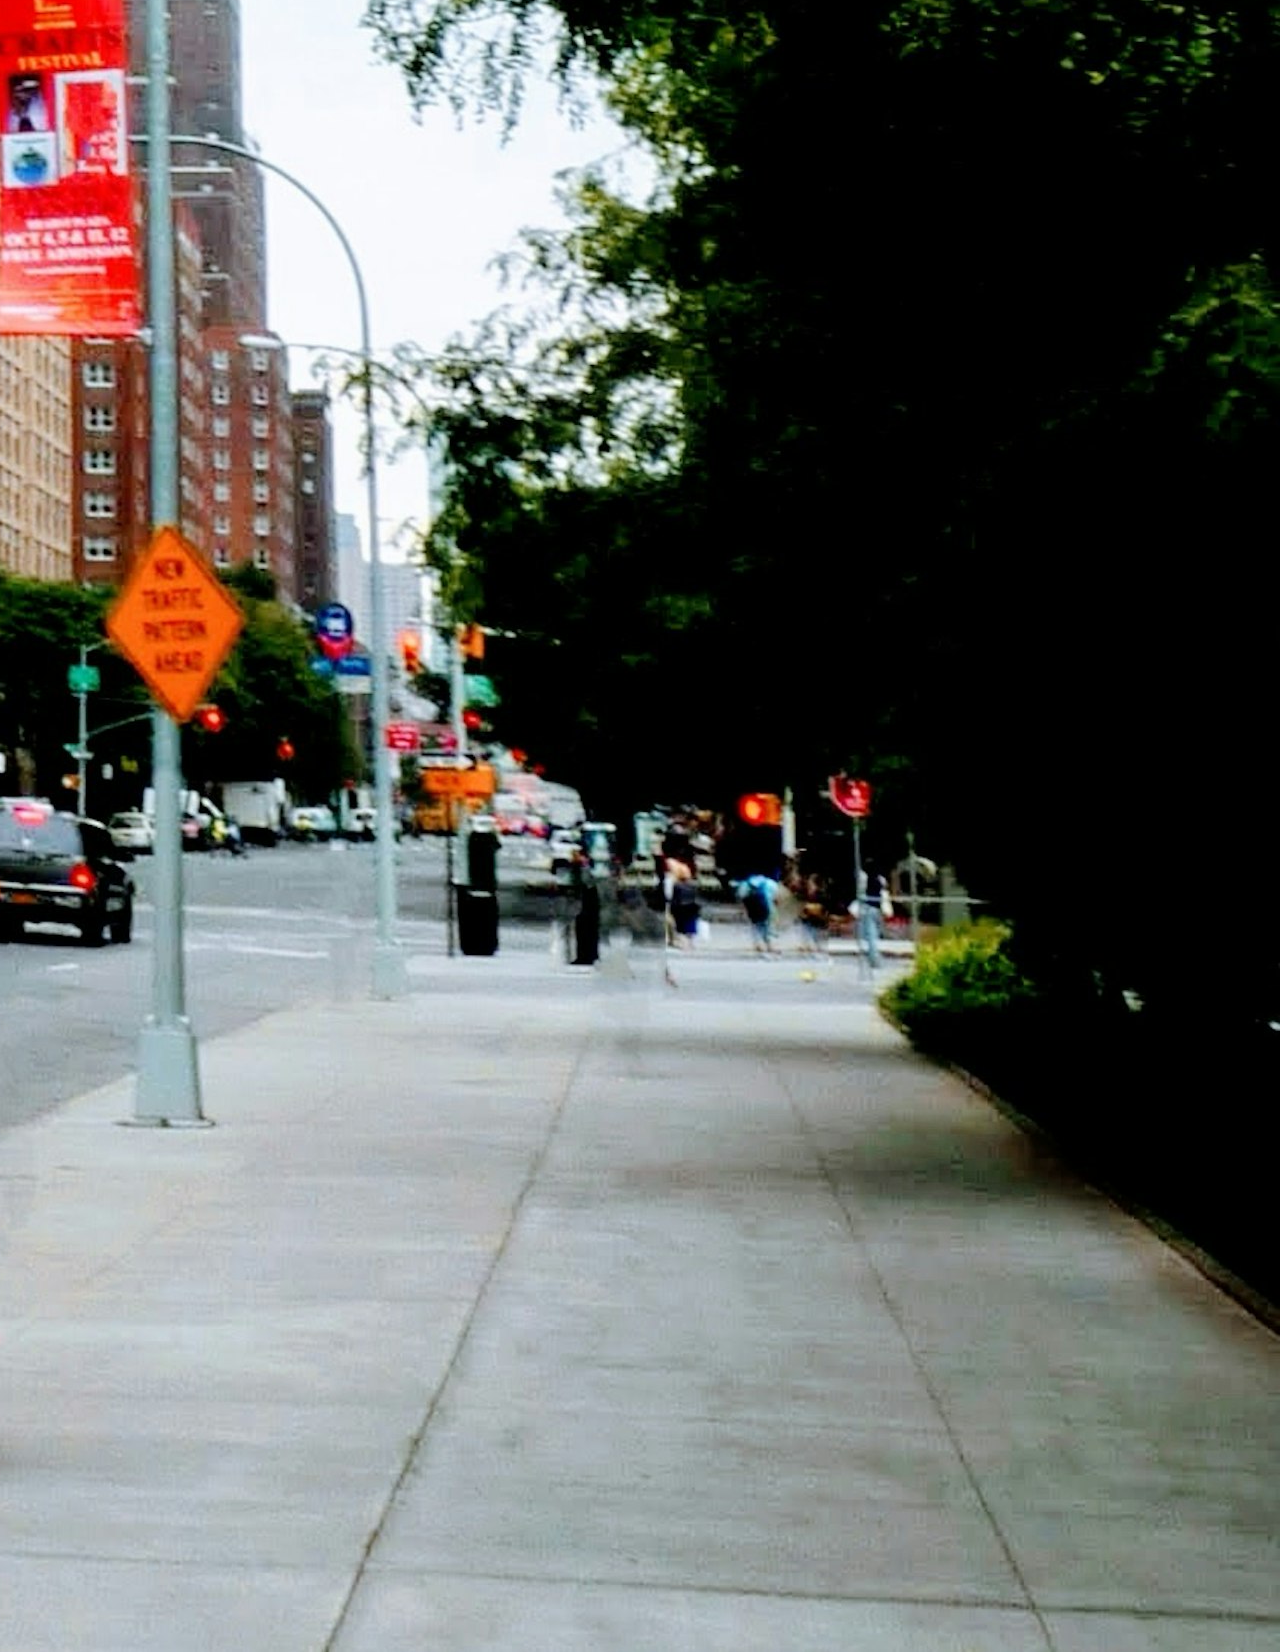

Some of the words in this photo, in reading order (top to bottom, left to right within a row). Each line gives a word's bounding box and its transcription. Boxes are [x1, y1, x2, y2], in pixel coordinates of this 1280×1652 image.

[17, 52, 105, 71] FESTIVAL
[3, 231, 40, 248] OCT
[1, 247, 40, 263] FREE
[45, 245, 133, 261] ADMISSION
[153, 558, 184, 580] NEW
[142, 587, 204, 611] TRAFFIC
[142, 619, 207, 641] PATTERN
[154, 650, 203, 673] AHEAD
